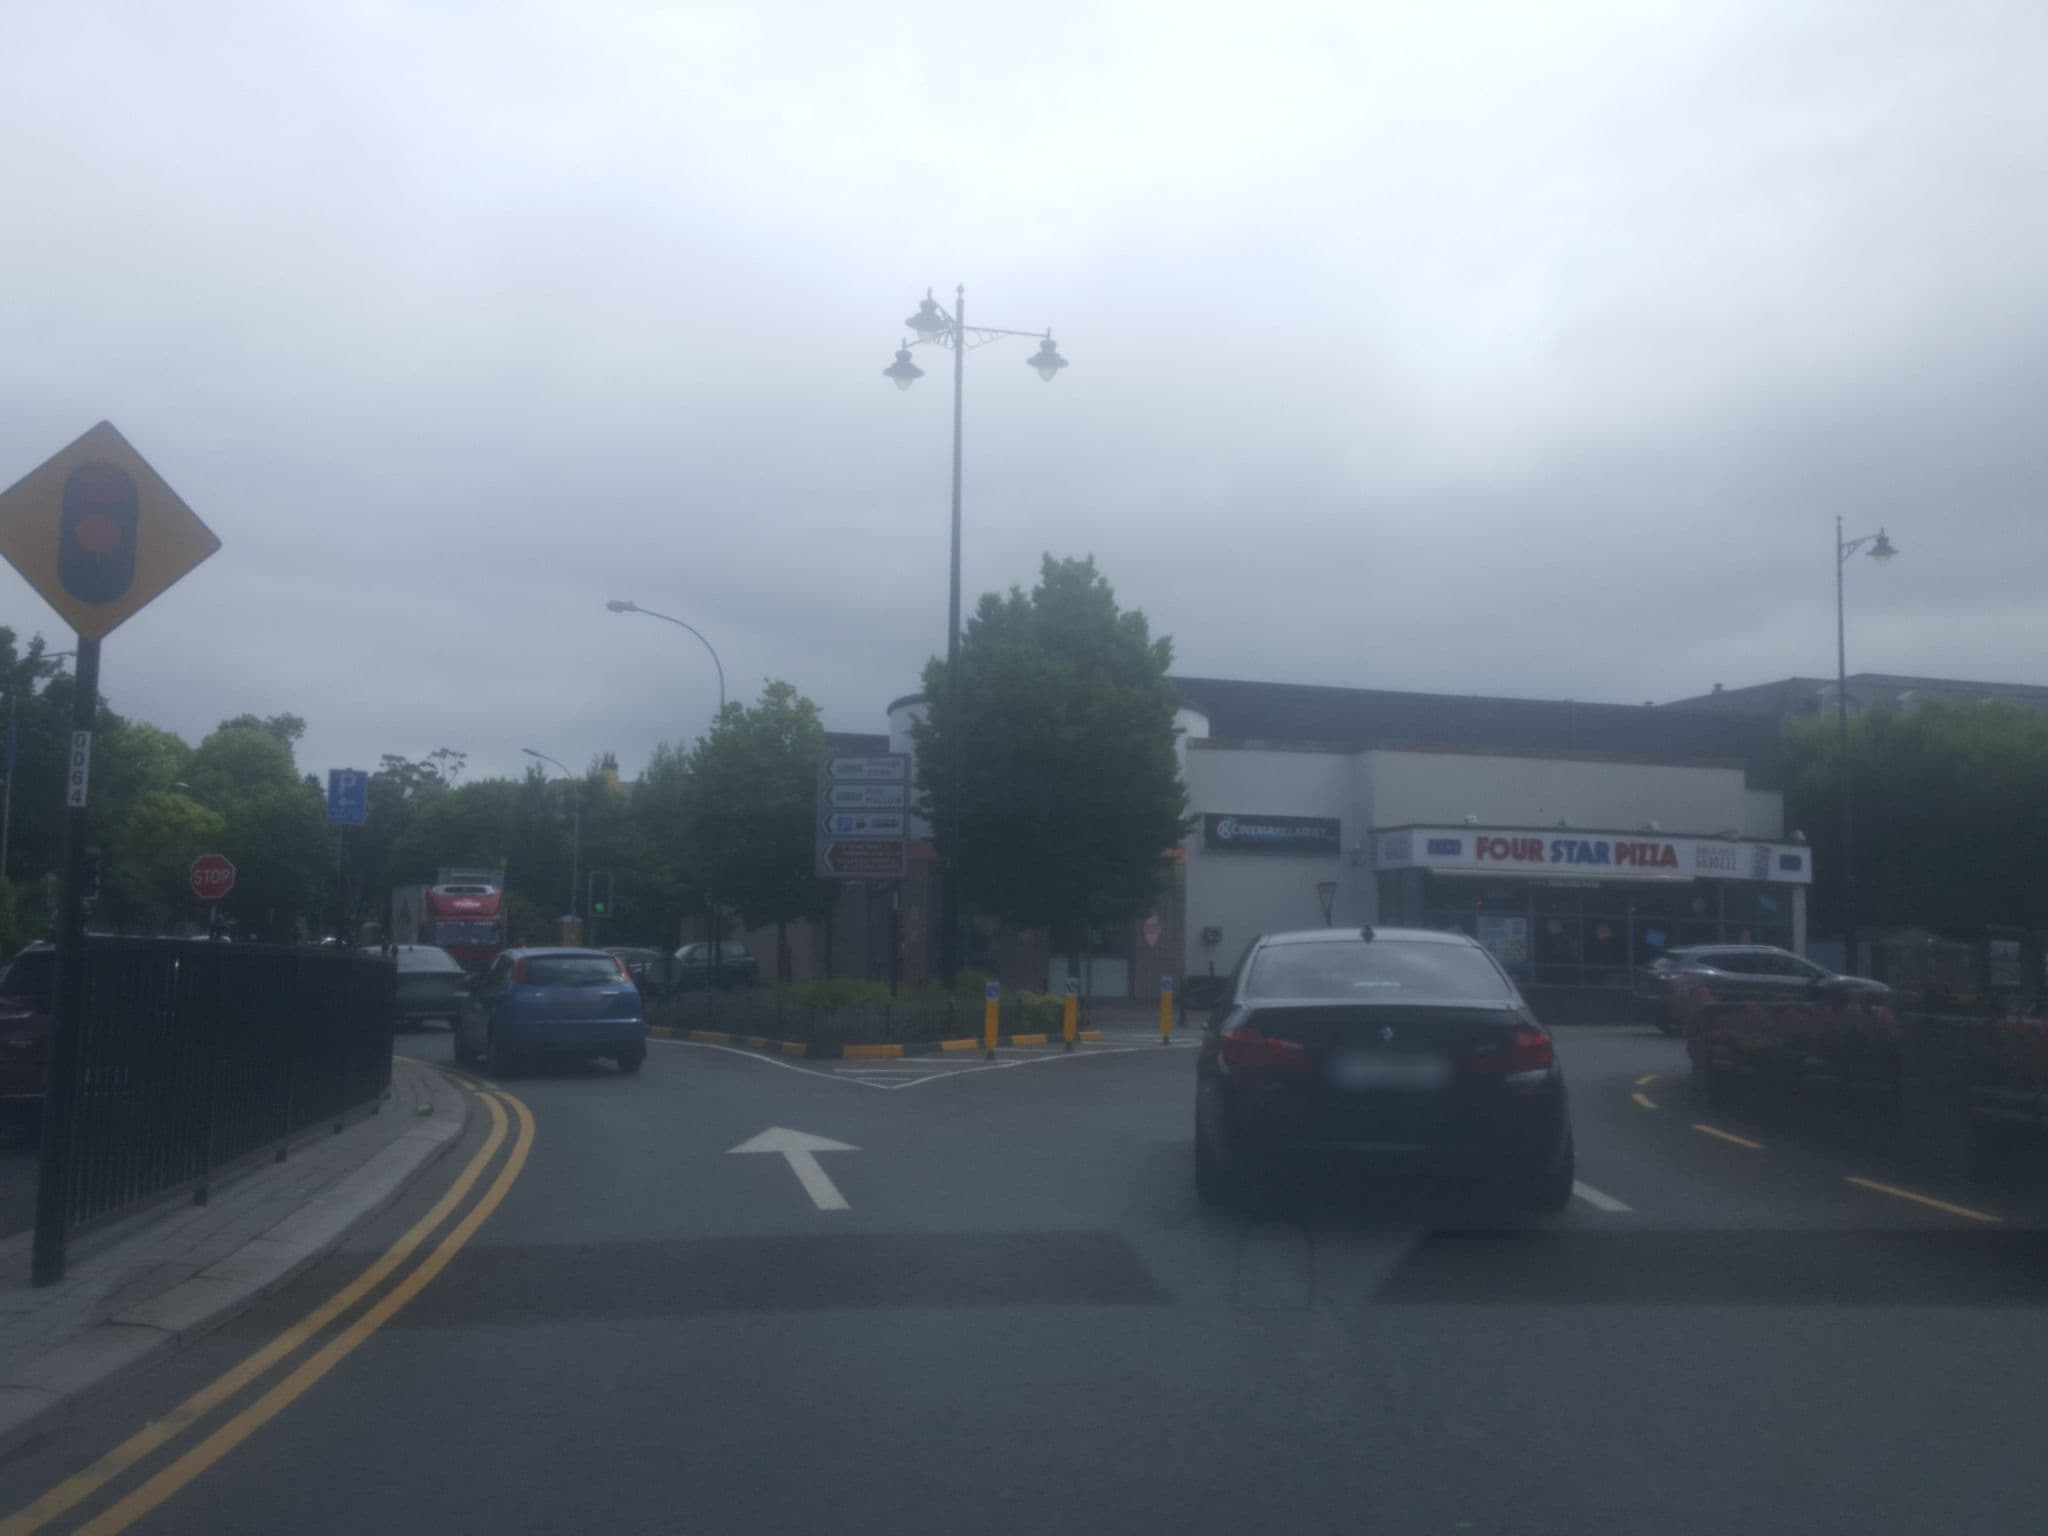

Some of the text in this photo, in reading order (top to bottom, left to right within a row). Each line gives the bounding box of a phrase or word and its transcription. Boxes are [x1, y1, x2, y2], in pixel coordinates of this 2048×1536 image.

[71, 733, 86, 804] 0064
[339, 773, 356, 794] P
[1475, 836, 1544, 863] FOUR
[1550, 839, 1610, 865] STAR
[1615, 842, 1678, 868] PIZZA
[193, 869, 231, 885] STOP
